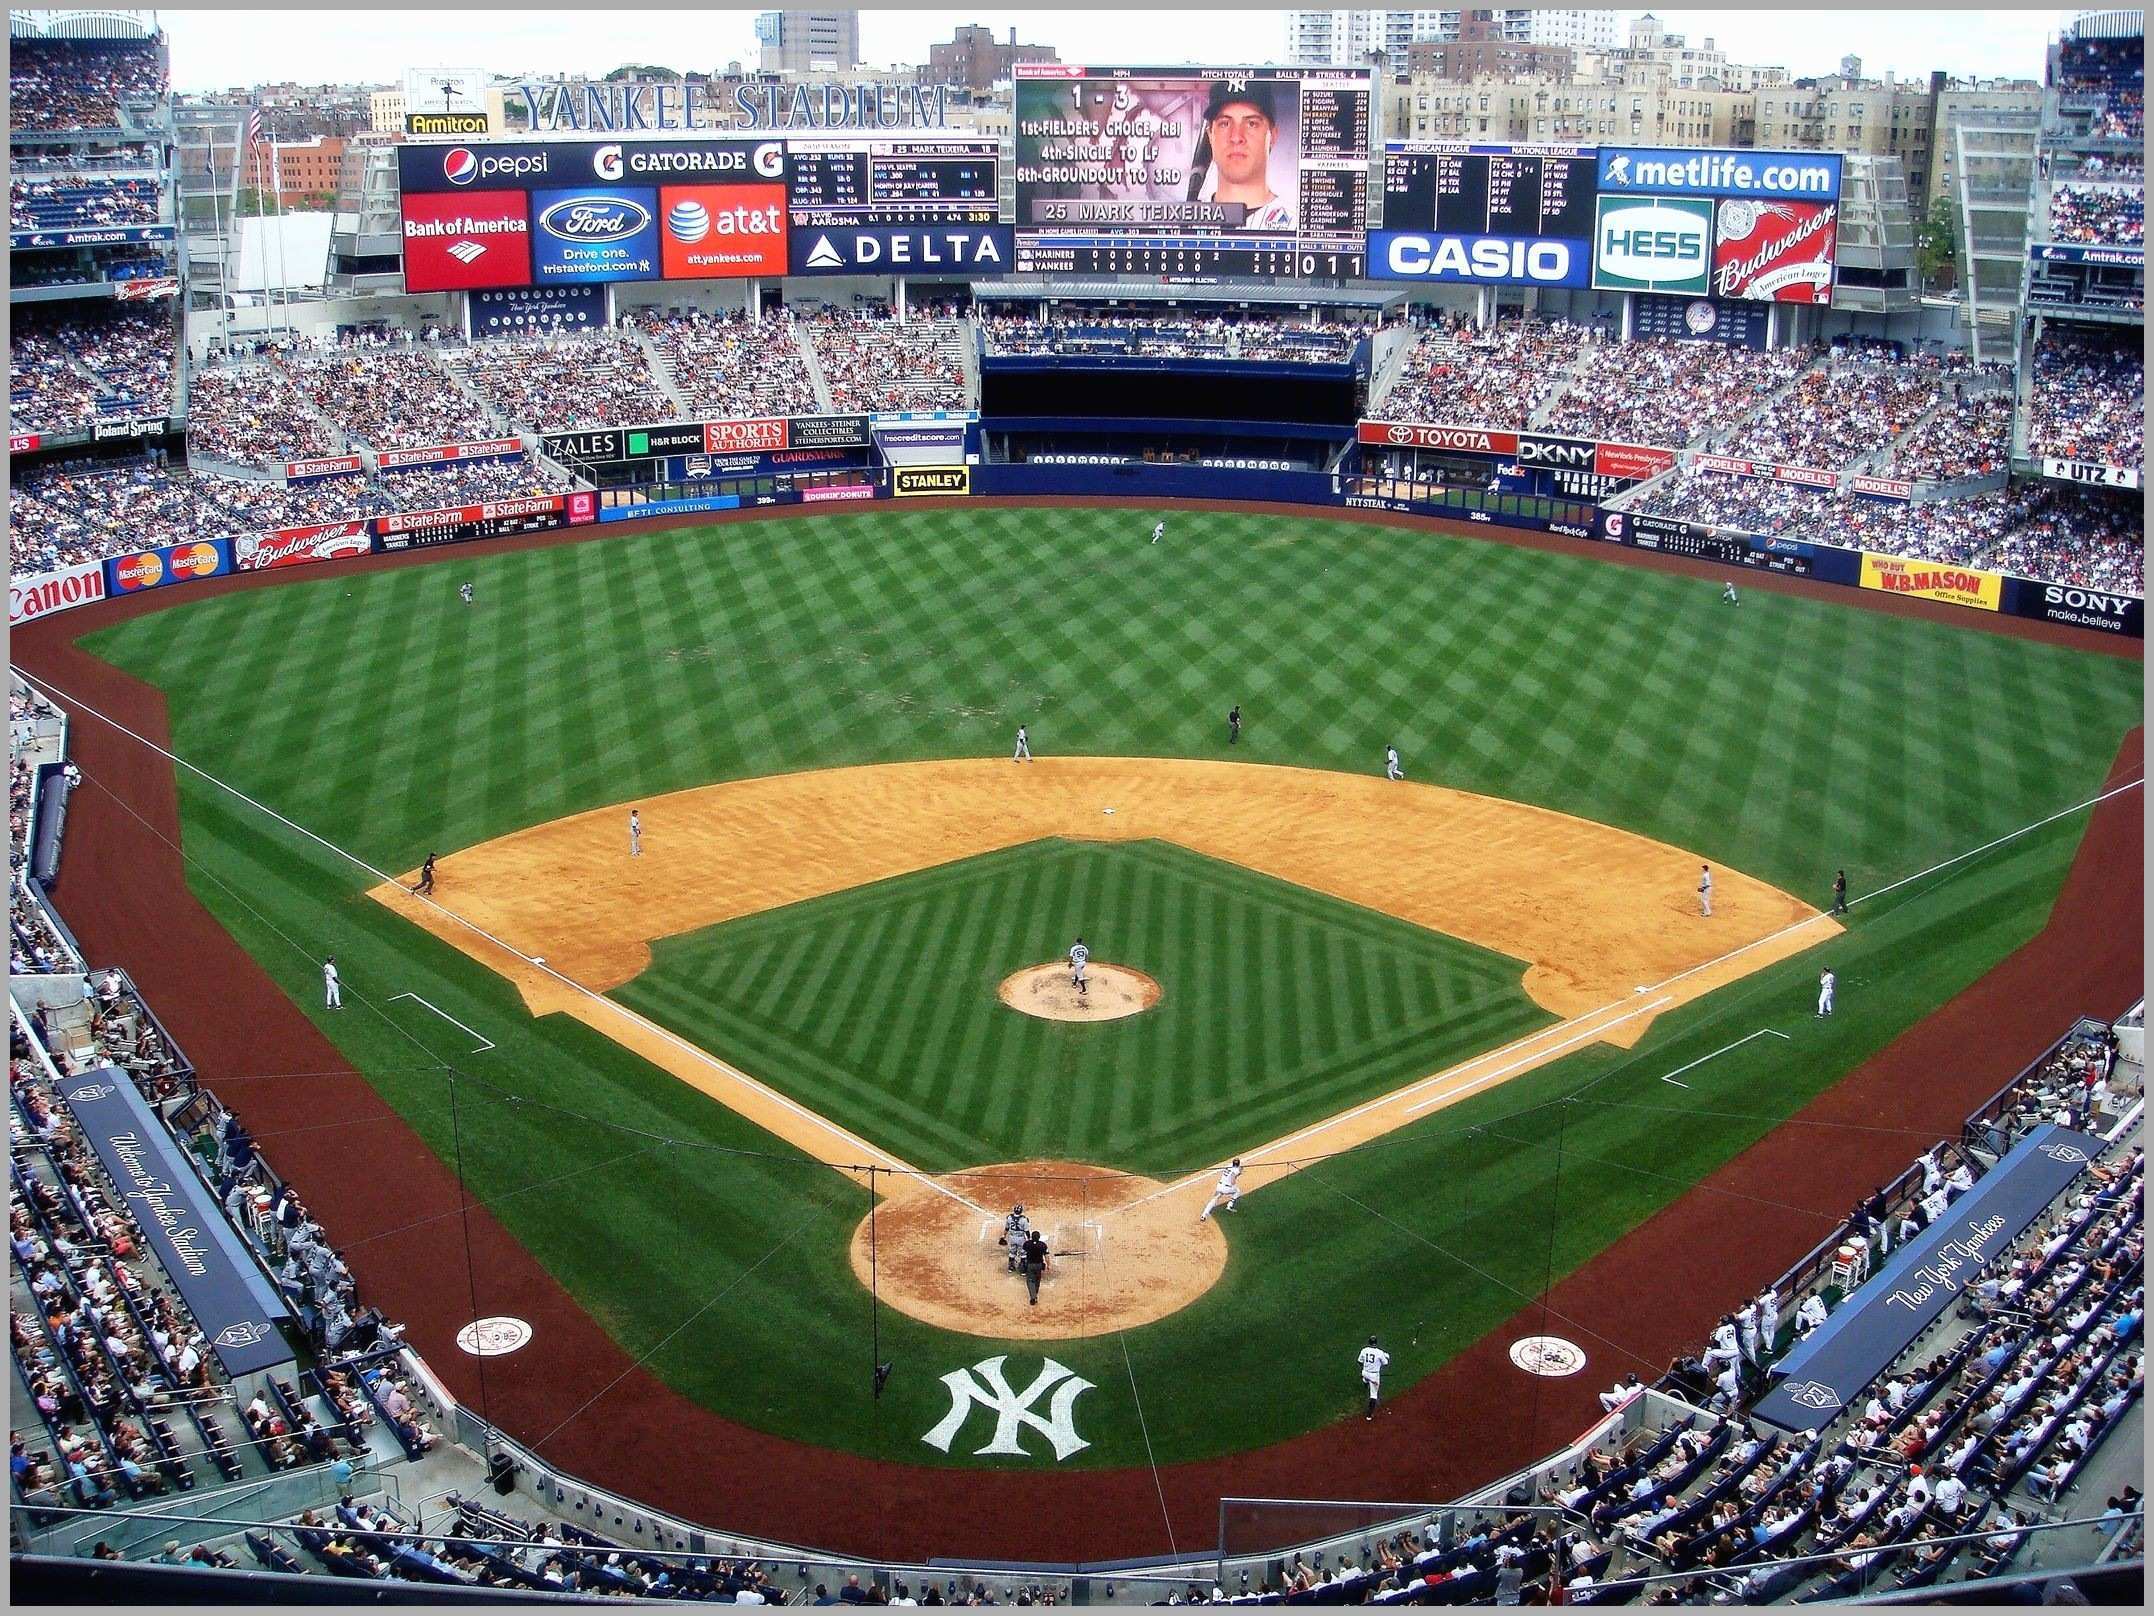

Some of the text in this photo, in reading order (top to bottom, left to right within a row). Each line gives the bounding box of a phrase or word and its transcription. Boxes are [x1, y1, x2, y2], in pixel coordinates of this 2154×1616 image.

[1113, 70, 1131, 78] MPH
[1276, 71, 1300, 79] BALLS:
[1072, 84, 1129, 109] 1 3
[519, 84, 947, 131] YANKEE STADIUM
[412, 115, 487, 133] Armitron
[1021, 121, 1182, 138] 1st-FIELDER'S CHOICE, RBI
[897, 145, 970, 154] 25 MARK TEIXEIRA
[1041, 146, 1159, 161] 4th-SINGLE TO LF
[1403, 144, 1470, 153] AMERICAN LEAGUE
[1511, 147, 1578, 156] NATIONAL LEAGUE
[481, 151, 549, 178] pepsi
[593, 142, 784, 180] G GATORADE G
[1017, 168, 1181, 184] 6th-GROUNDOUT TO 3RD
[1636, 156, 1830, 192] metlife.com
[565, 206, 625, 234] Ford
[716, 204, 781, 234] at&t
[969, 212, 990, 222] 3:30
[1044, 203, 1225, 221] 25 MARK TEIXEIRA
[404, 216, 527, 237] Bank of America
[811, 217, 860, 226] AARDSMA
[67, 232, 126, 244] Amtrak.com
[1606, 229, 1701, 260] HESS
[564, 249, 630, 260] Drive one.
[856, 235, 1001, 263] DELTA
[1035, 250, 1290, 262] MARINERS 0 0 0 0 0 0 0 2 2 0
[1713, 204, 1837, 296] Budweiser
[687, 254, 763, 265] att.yankees.com
[1302, 256, 1360, 276] 0 1 1
[1388, 236, 1570, 281] CASIO
[543, 261, 637, 274] tristateford.com
[1035, 262, 1290, 274] YANKEES 1 0 0 1 0 0 0 2 0
[118, 279, 172, 300] Budweiser
[1758, 269, 1828, 294] American Lager
[94, 421, 165, 441] Poland Spring
[709, 421, 782, 441] SPORTS
[803, 427, 854, 436] COLLECTIBLES
[884, 434, 960, 442] freecreditscore.com
[1416, 428, 1492, 450] TOYOTA
[551, 434, 616, 457] ZALES
[650, 435, 700, 447] H&R BLOCK
[711, 437, 783, 450] AUTHORITY
[795, 435, 863, 445] STEINERSPORTS.COM
[1518, 442, 1595, 466] DKNY
[1497, 463, 1525, 478] FedEx
[1700, 457, 1747, 472] MODELL'S
[901, 474, 962, 488] STANLEY
[1554, 471, 1616, 487] SHARPER
[1780, 469, 1832, 485] MODELL'S
[2071, 464, 2107, 483] UTZ
[1854, 479, 1909, 496] MODELL'S
[655, 503, 711, 515] CONSULTING
[1345, 498, 1363, 507] NYY
[1363, 499, 1387, 509] STEAK
[1549, 523, 1588, 538] Hard Rock Cafe
[1642, 519, 1678, 531] GATORADE
[249, 524, 348, 569] Budweiser
[1776, 542, 1798, 552] pepsi
[172, 552, 219, 570] MasterCard
[1871, 560, 1905, 572] WHO BUT
[118, 562, 162, 581] MasterCard
[10, 569, 103, 622] Canon
[1934, 590, 1988, 606] Office Supplies
[2045, 586, 2131, 616] SONY
[2047, 608, 2121, 631] make.believe
[110, 1132, 209, 1276] Welcome to Yankee Stadium
[1886, 1214, 2006, 1311] New York Yankees
[1365, 1353, 1376, 1364] 13
[1802, 1386, 1829, 1406] 27
[921, 1354, 1098, 1462] NY
